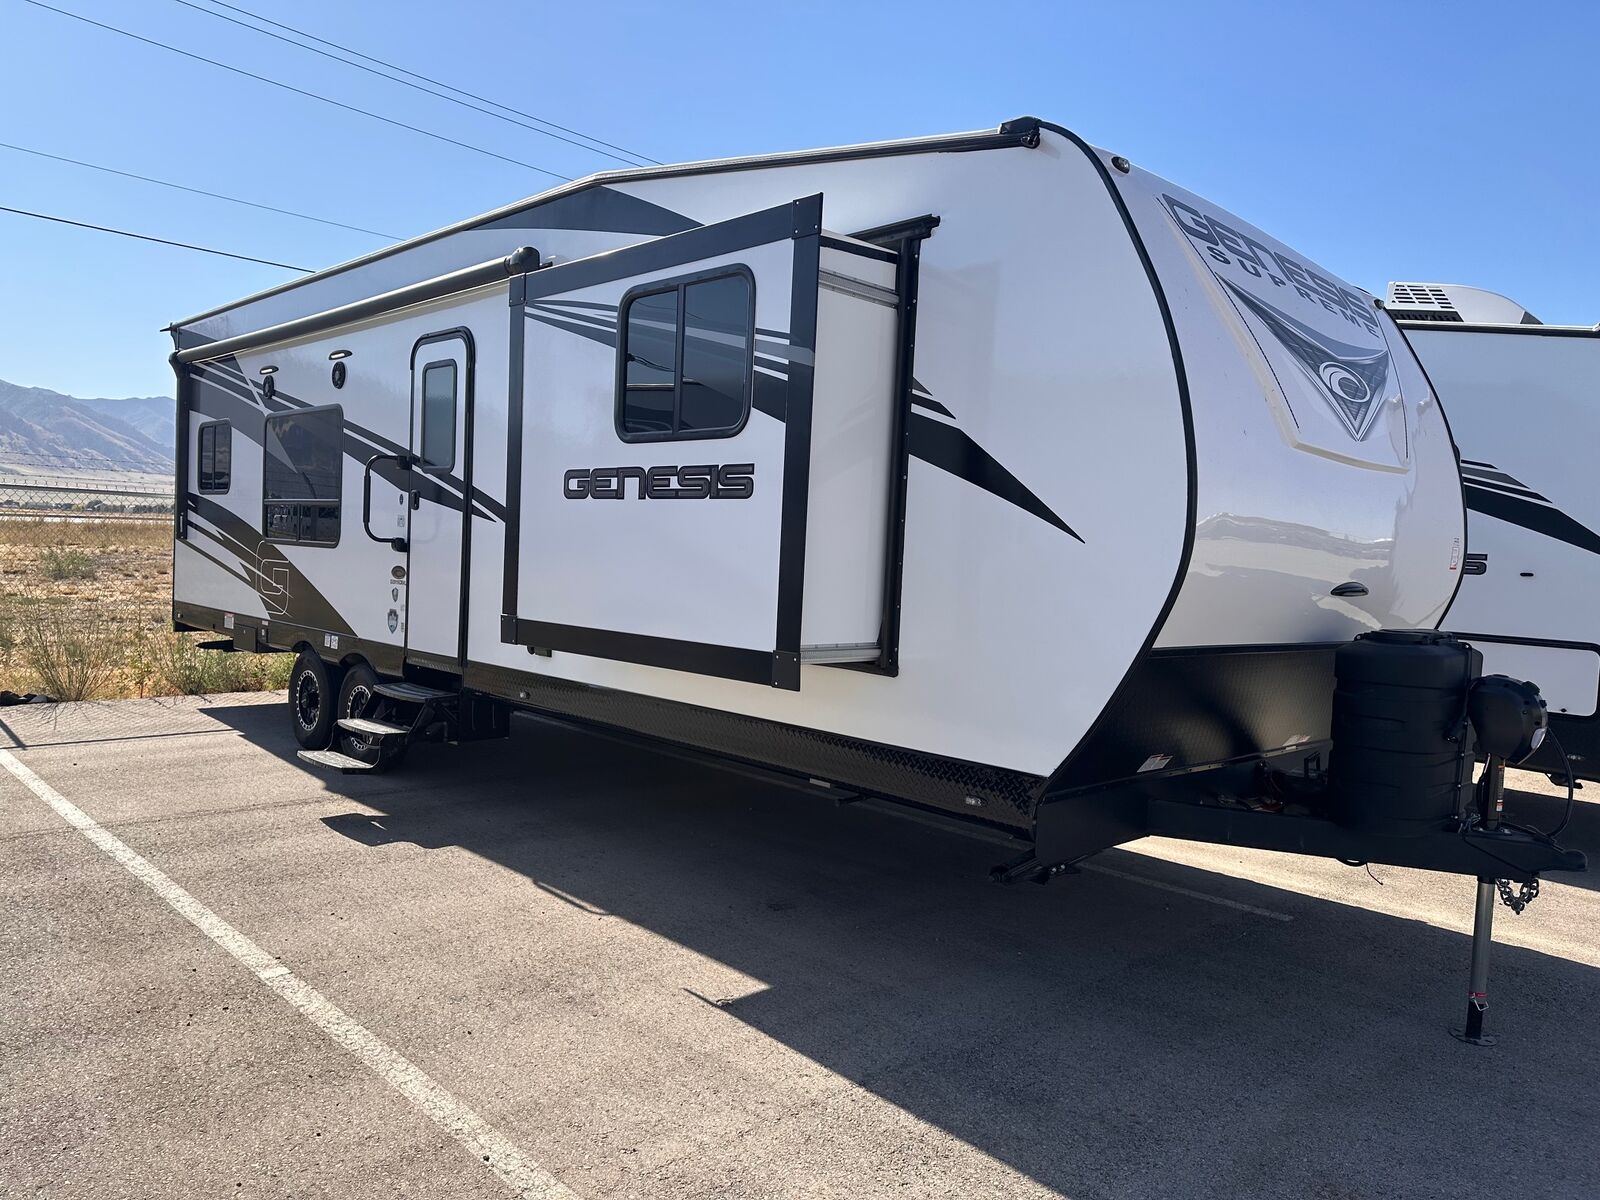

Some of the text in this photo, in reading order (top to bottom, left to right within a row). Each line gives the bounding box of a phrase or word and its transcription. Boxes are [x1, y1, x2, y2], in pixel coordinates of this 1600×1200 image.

[1162, 193, 1379, 328] GENESIS
[1206, 245, 1380, 338] SUPREME
[563, 463, 755, 500] GENESIS
